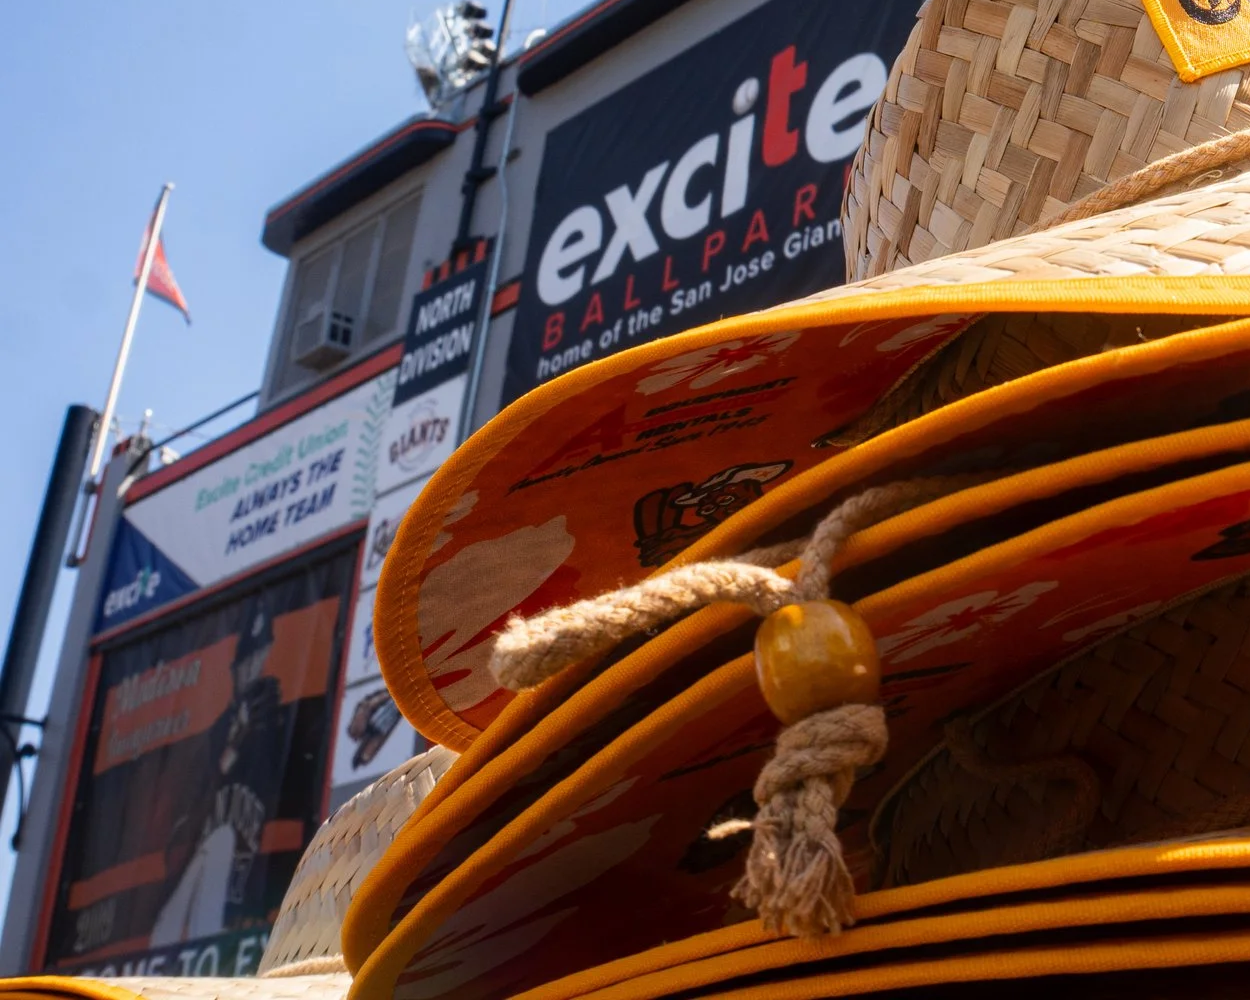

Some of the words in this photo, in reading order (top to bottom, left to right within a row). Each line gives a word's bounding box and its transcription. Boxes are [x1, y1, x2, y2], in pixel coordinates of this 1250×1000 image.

[536, 44, 888, 306] excite
[541, 165, 851, 350] BALLPAR
[415, 278, 476, 335] NORTH
[537, 338, 592, 379] home
[600, 323, 623, 350] of
[627, 306, 663, 336] the
[669, 279, 712, 315] San
[719, 250, 775, 291] Jose
[784, 218, 842, 259] Gian
[399, 321, 475, 384] DIVISION
[389, 417, 449, 464] GIANTS
[224, 509, 279, 556] HOME
[284, 481, 337, 526] TEAM
[230, 469, 303, 523] ALWAYS
[307, 448, 345, 486] THE
